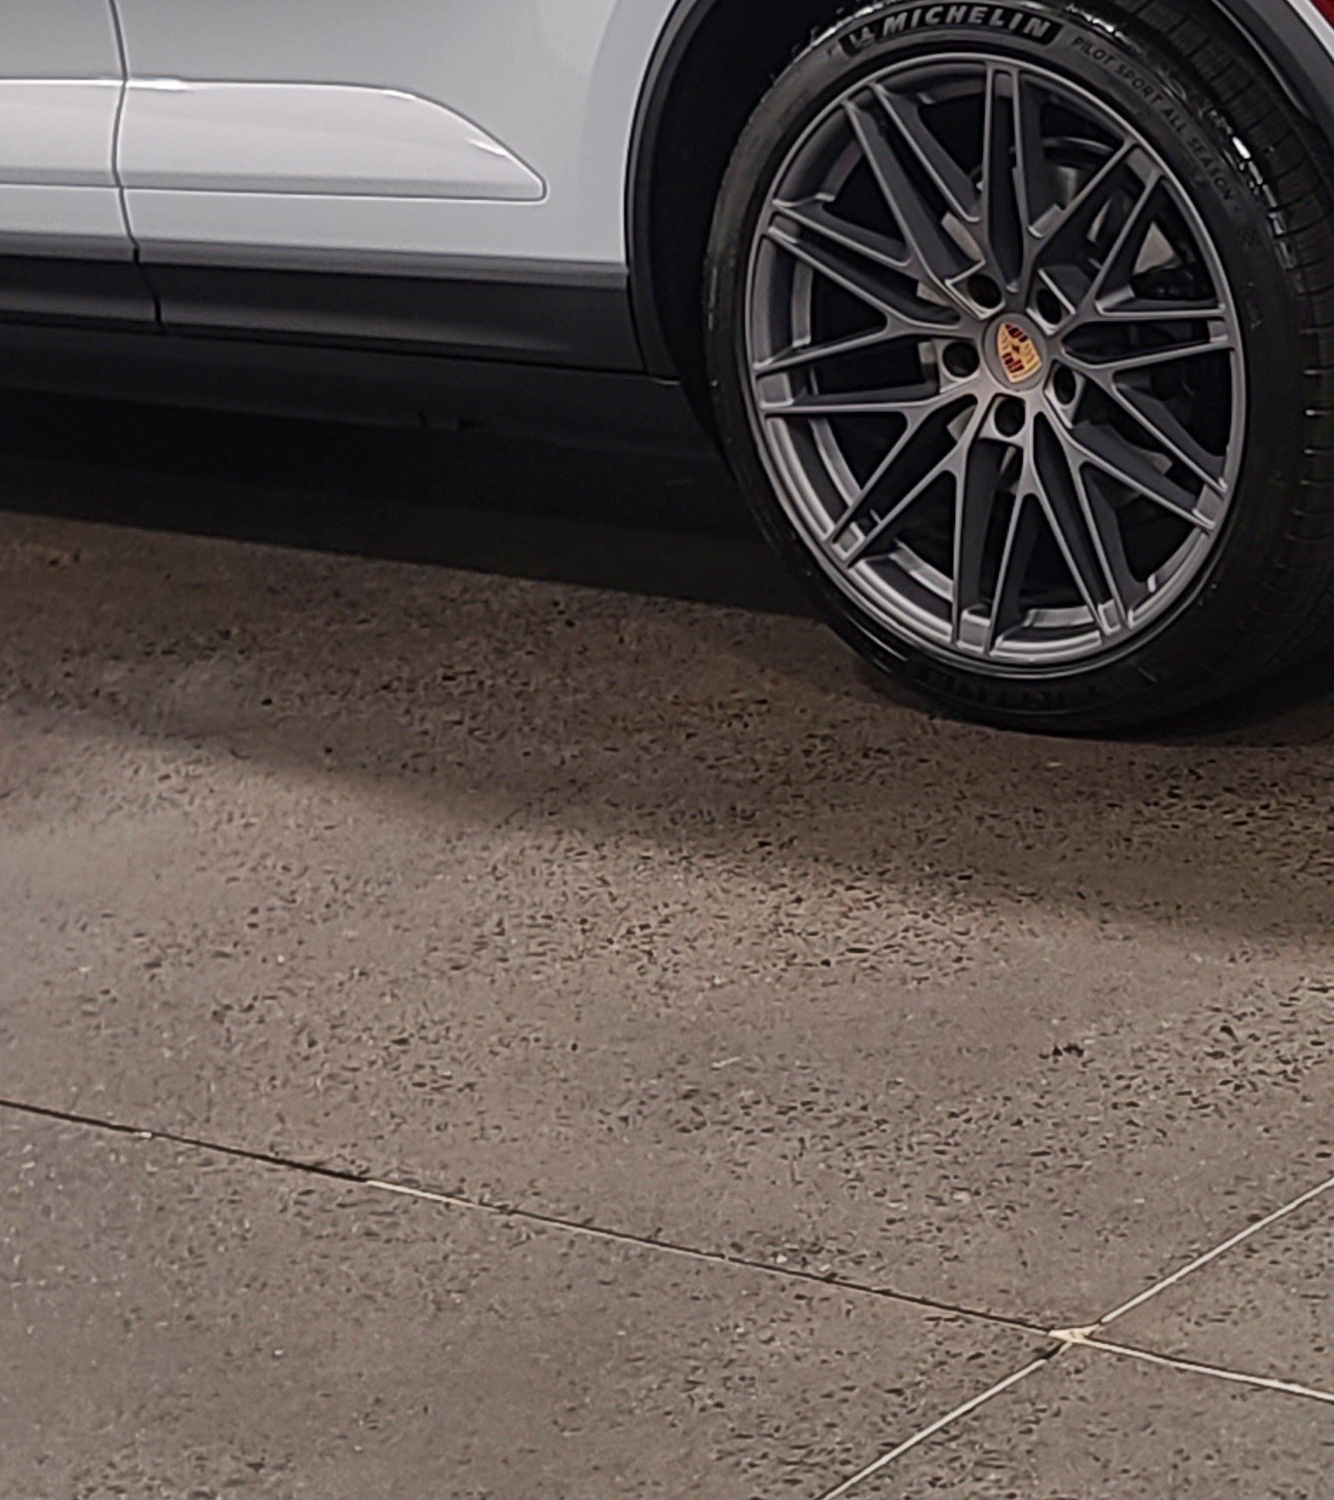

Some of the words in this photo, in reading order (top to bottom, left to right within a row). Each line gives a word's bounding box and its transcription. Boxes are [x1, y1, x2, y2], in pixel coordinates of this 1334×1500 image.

[882, 5, 1051, 38] MICHELIN
[1070, 36, 1116, 65] PILOT
[1115, 64, 1163, 104] SPORT
[1161, 108, 1188, 134] ALL
[1186, 137, 1235, 200] SEASON
